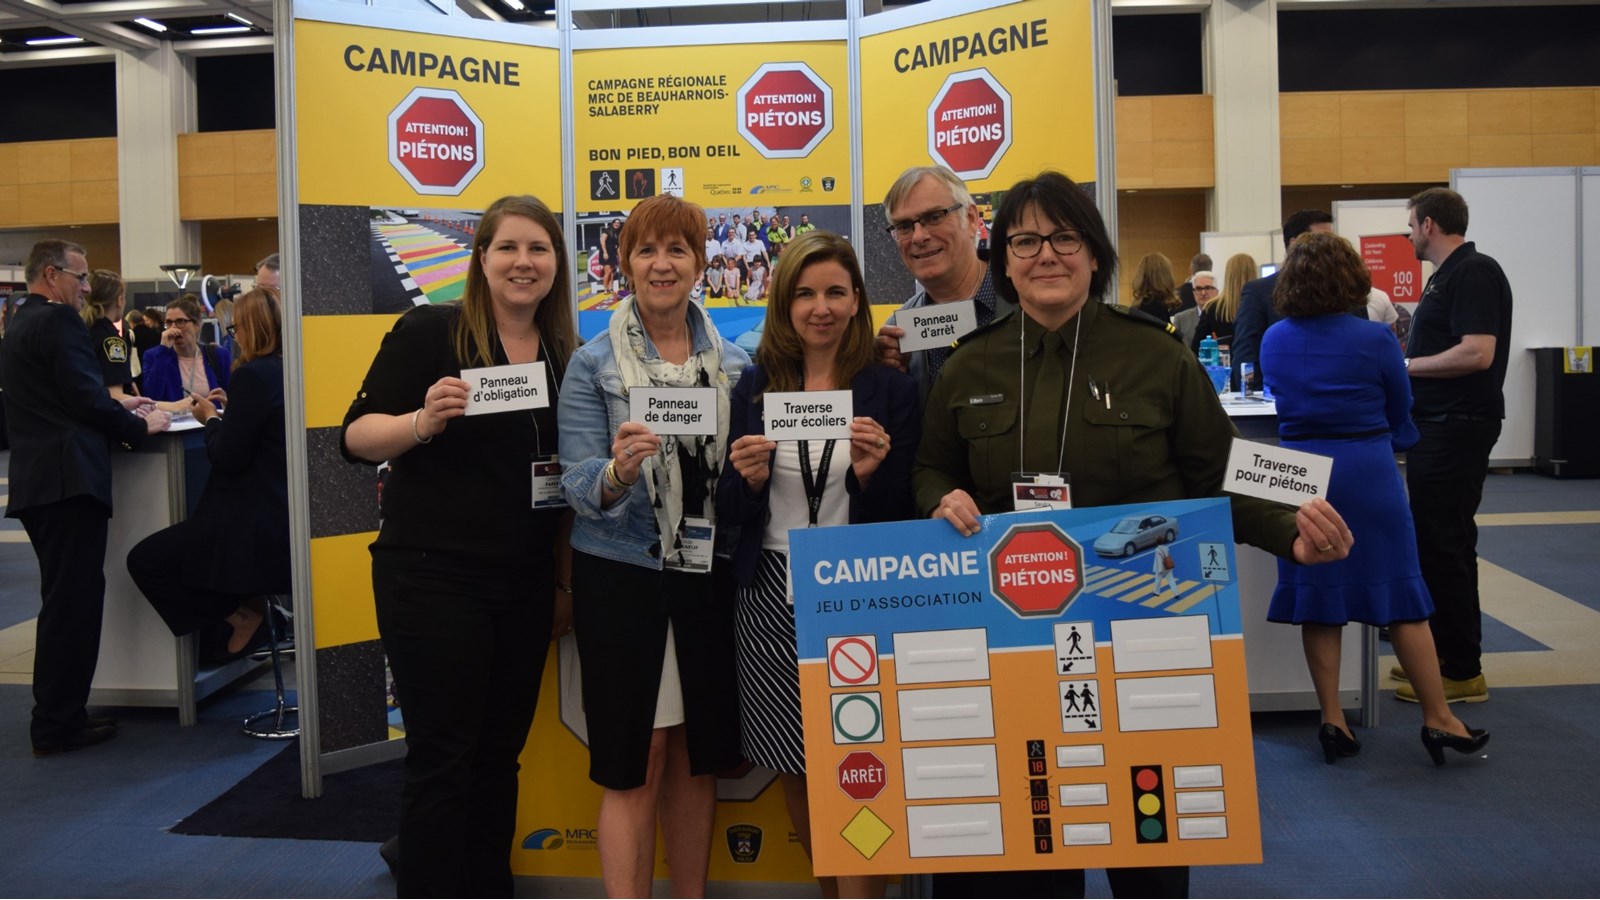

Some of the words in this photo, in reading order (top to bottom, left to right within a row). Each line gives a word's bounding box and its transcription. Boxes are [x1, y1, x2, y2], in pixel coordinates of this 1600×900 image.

[894, 18, 1048, 73] CAMPAGNE
[344, 44, 520, 87] CAMPAGNE
[588, 77, 654, 91] CAMPAGNE
[658, 74, 727, 88] RÉGIONALE
[588, 92, 614, 104] MRC
[617, 92, 633, 103] DE
[637, 88, 729, 102] BEAUHARNOIS-
[753, 93, 816, 105] ATTENTION!
[588, 104, 659, 117] SALABERRY
[747, 109, 822, 128] PIÉTONS
[941, 103, 997, 122] ATTENTION!
[405, 122, 468, 137] ATTENTION!
[936, 122, 1002, 148] PIÉTONS
[399, 139, 474, 162] PIÉTONS
[589, 149, 621, 161] BON
[626, 147, 665, 161] PIED,
[668, 146, 700, 159] BON
[706, 145, 740, 157] OEIL
[1393, 271, 1413, 285] 100
[1393, 286, 1413, 297] CN
[913, 313, 959, 327] Panneau
[921, 324, 956, 338] d'arrêt
[480, 375, 528, 389] Panneau
[473, 386, 538, 403] d'obligation
[648, 397, 698, 409] Panneau
[784, 402, 833, 414] Traverse
[645, 411, 660, 422] de
[662, 411, 702, 425] danger
[771, 417, 798, 430] pour
[801, 414, 847, 427] écoliers
[1253, 453, 1307, 477] Traverse
[1235, 469, 1266, 484] pour
[1269, 475, 1318, 495] piétons
[1004, 551, 1068, 565] ATTENTION!
[814, 550, 979, 585] CAMPAGNE
[1000, 566, 1075, 588] PIÉTONS
[816, 601, 843, 614] JEU
[850, 591, 982, 611] D'ASSOCIATION
[841, 764, 883, 784] ARRÊT
[1032, 761, 1044, 773] 18
[1033, 799, 1048, 812] 08
[565, 828, 598, 839] MRC
[1040, 839, 1048, 851] 0
